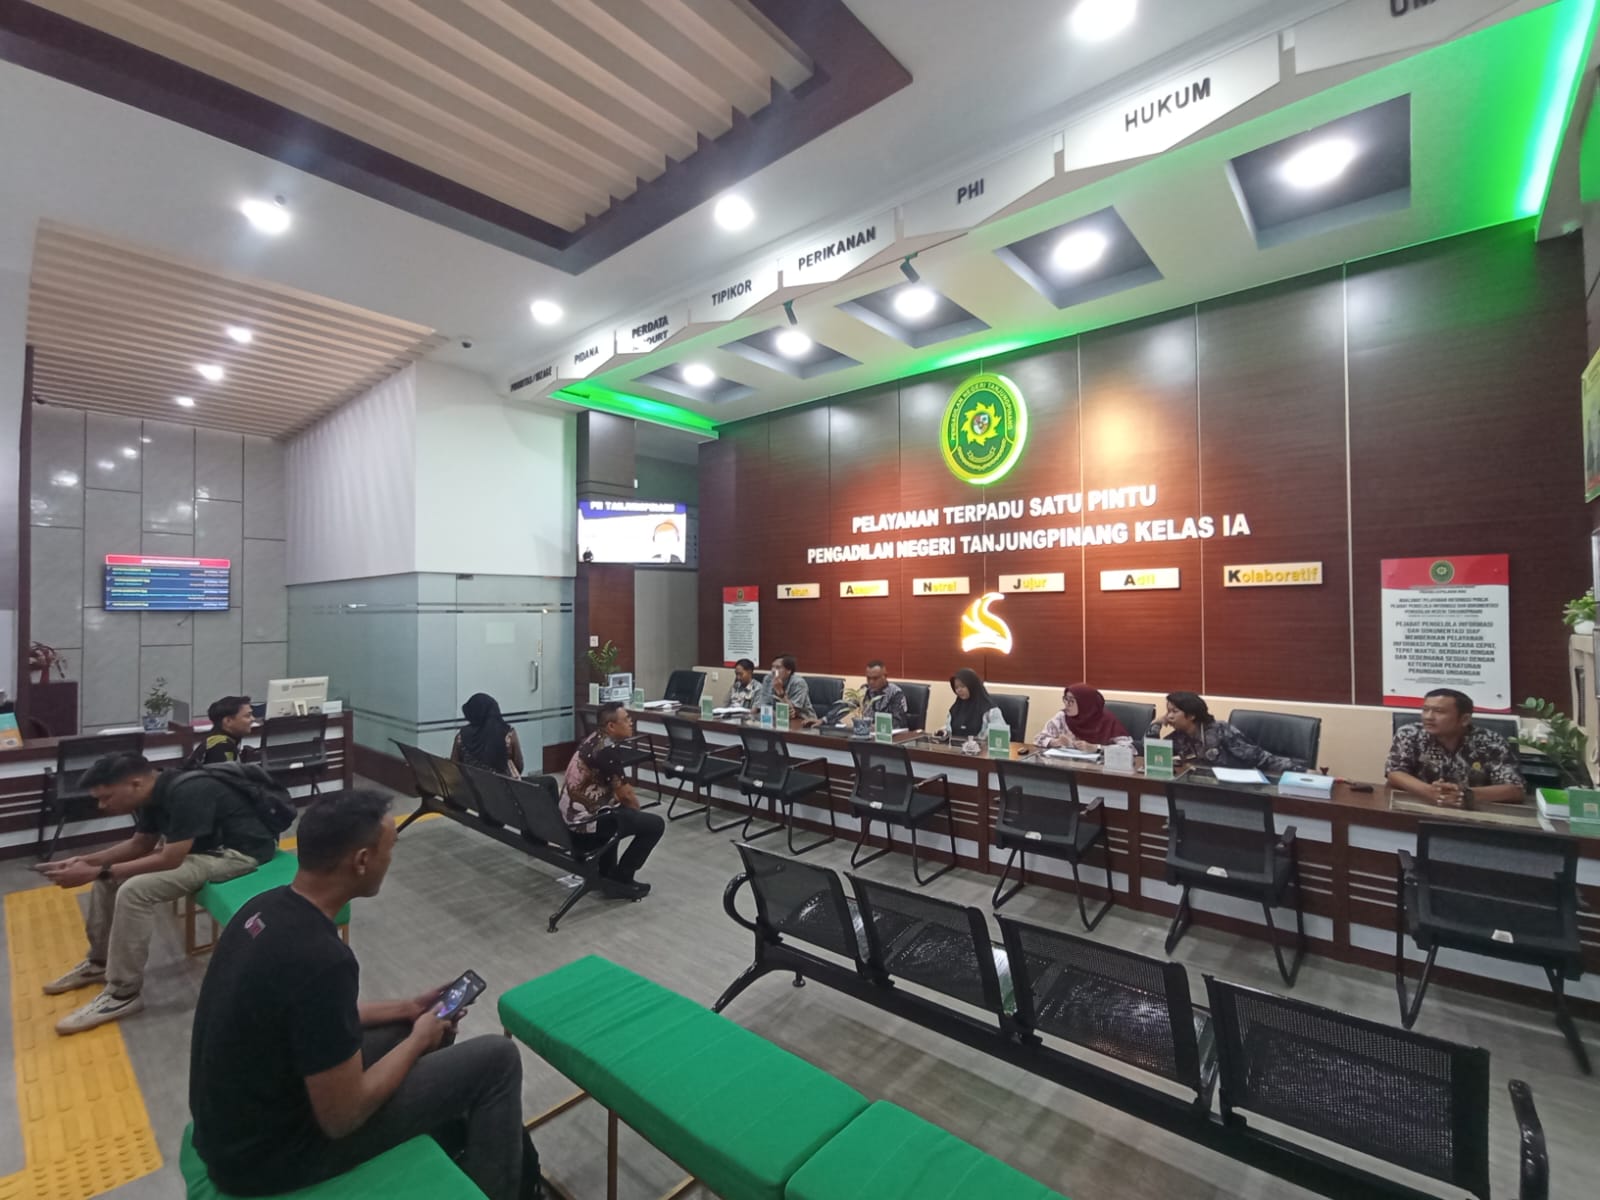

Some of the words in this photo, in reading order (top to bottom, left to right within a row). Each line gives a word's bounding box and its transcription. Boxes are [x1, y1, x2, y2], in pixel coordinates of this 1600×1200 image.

[1124, 76, 1212, 133] HUKUM
[956, 178, 985, 206] PHI
[798, 226, 877, 271] PERIKANAN
[711, 279, 752, 306] TIPIKOR
[632, 315, 669, 339] PERDATA
[574, 346, 599, 365] PIDANA
[852, 508, 940, 534] PELAYANAN
[943, 499, 1024, 525] TERPADU
[1029, 493, 1083, 518] SATU
[1088, 485, 1157, 511] PINTU
[807, 541, 895, 565] PENGADILAN
[897, 537, 956, 558] NEGERI
[960, 522, 1129, 554] TANJUNGPINANG
[1134, 516, 1215, 542] KELAS
[1222, 513, 1251, 537] IA
[1228, 566, 1319, 584] Kolaboratif
